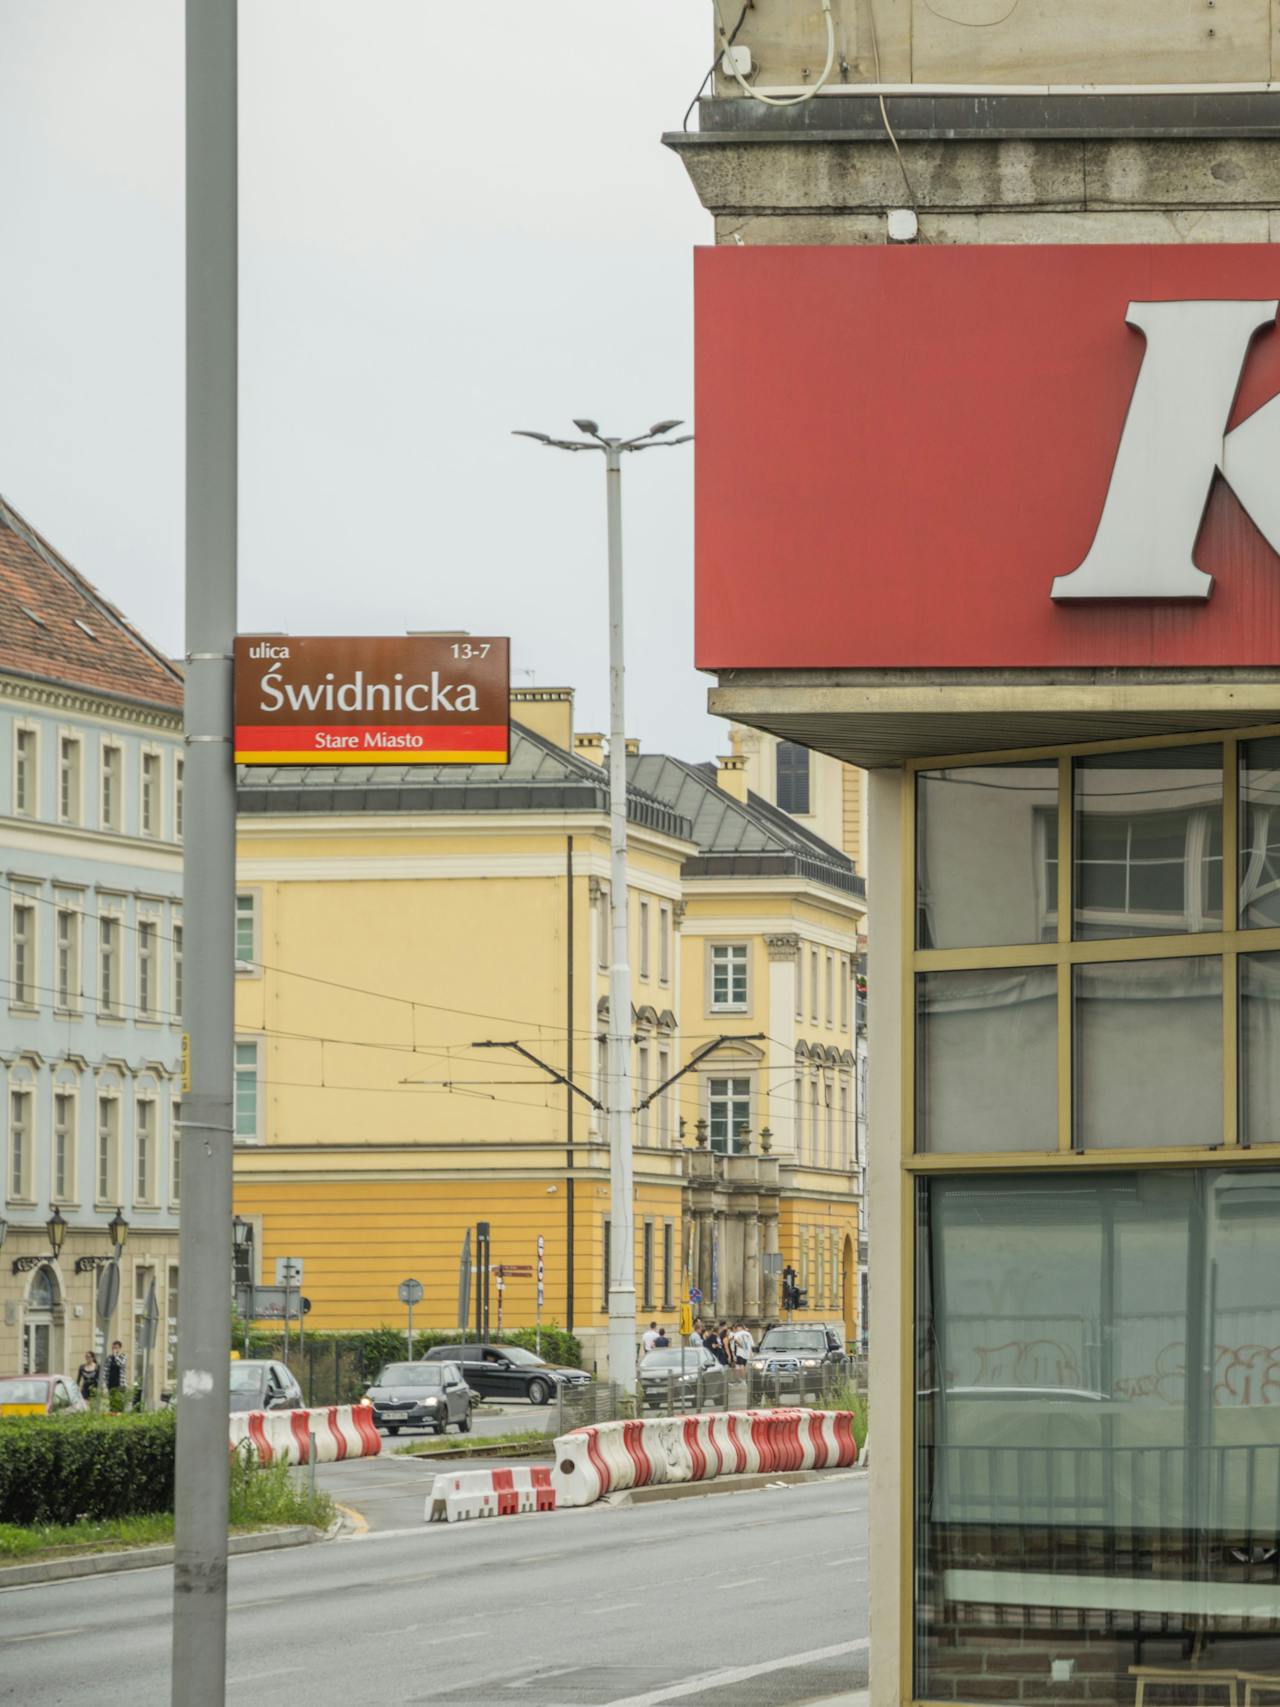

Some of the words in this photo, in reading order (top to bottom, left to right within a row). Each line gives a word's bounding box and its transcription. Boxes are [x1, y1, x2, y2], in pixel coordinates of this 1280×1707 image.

[249, 642, 290, 660] ulica
[450, 643, 491, 659] 13-7
[260, 662, 480, 712] Świdnicka
[315, 732, 359, 749] Stare
[363, 732, 424, 748] Miasto
